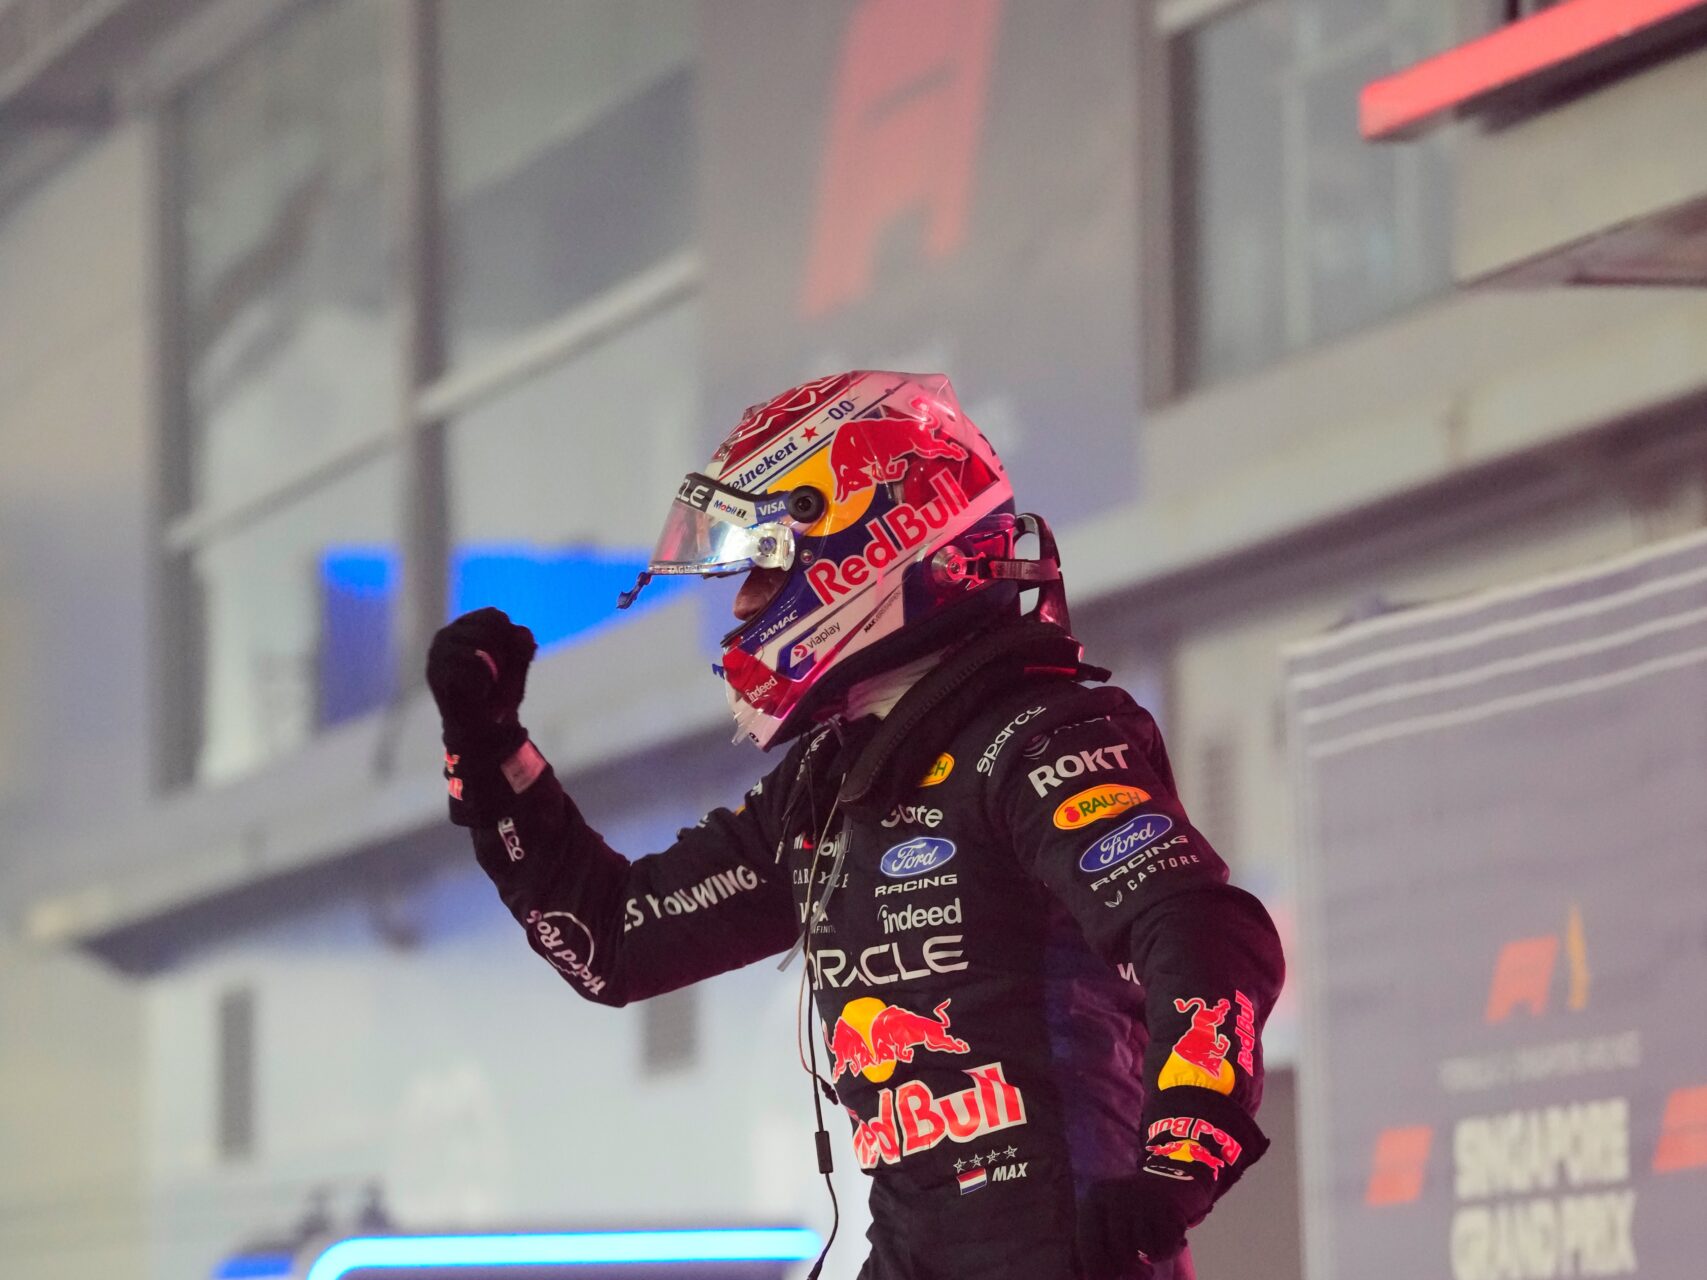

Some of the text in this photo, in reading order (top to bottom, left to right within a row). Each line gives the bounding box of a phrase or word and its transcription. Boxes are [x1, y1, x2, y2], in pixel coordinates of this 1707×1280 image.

[727, 440, 799, 491] eineken
[713, 499, 737, 515] Mobil
[757, 500, 787, 517] VISA
[806, 469, 970, 605] Red Bull
[759, 609, 799, 643] DAMAC
[806, 621, 842, 650] viaplay
[746, 676, 778, 703] indeed
[1027, 743, 1129, 798] ROKT
[1078, 790, 1144, 817] RAUCH
[890, 841, 937, 873] Ford
[1100, 822, 1156, 864] Ford
[1089, 835, 1189, 892] RACING
[1126, 853, 1200, 891] CASTORE
[691, 865, 768, 910] WING
[874, 874, 958, 898] RACING
[877, 898, 963, 935] indeed
[895, 1061, 1028, 1158] Bull
[1187, 1118, 1243, 1167] Red
[991, 1161, 1029, 1183] MAX
